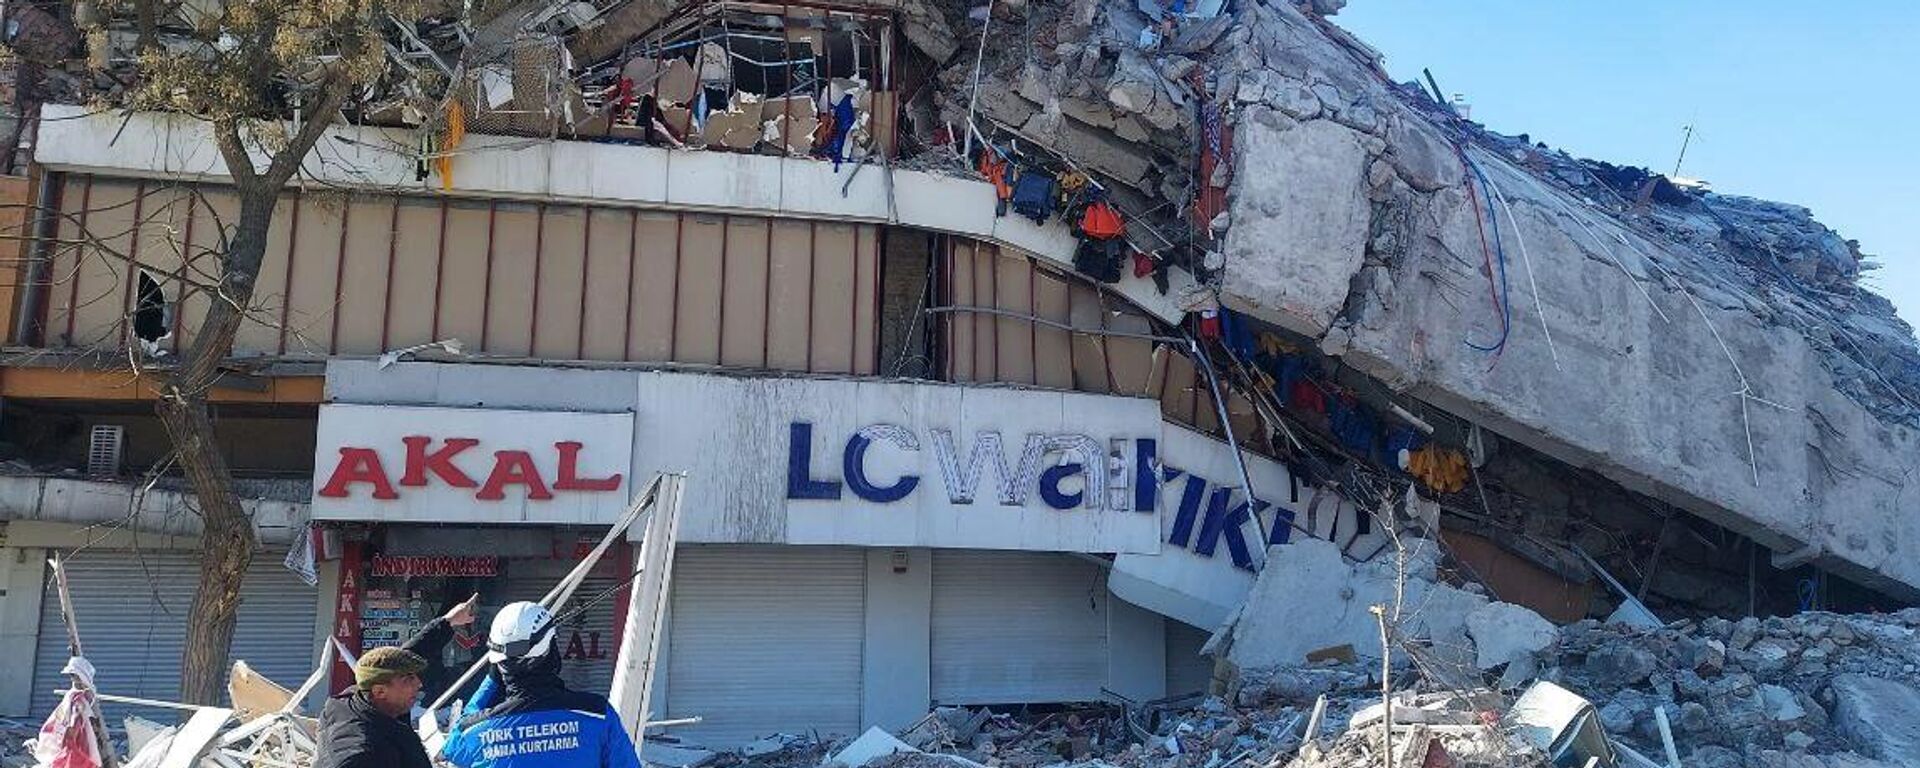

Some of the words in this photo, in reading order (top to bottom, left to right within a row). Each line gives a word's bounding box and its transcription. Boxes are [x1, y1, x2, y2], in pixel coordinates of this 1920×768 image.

[318, 436, 621, 499] AKAL
[787, 421, 919, 501] LC
[479, 728, 513, 745] TÜRK
[517, 721, 579, 739] TELEKOM
[518, 736, 579, 754] KURTARMA
